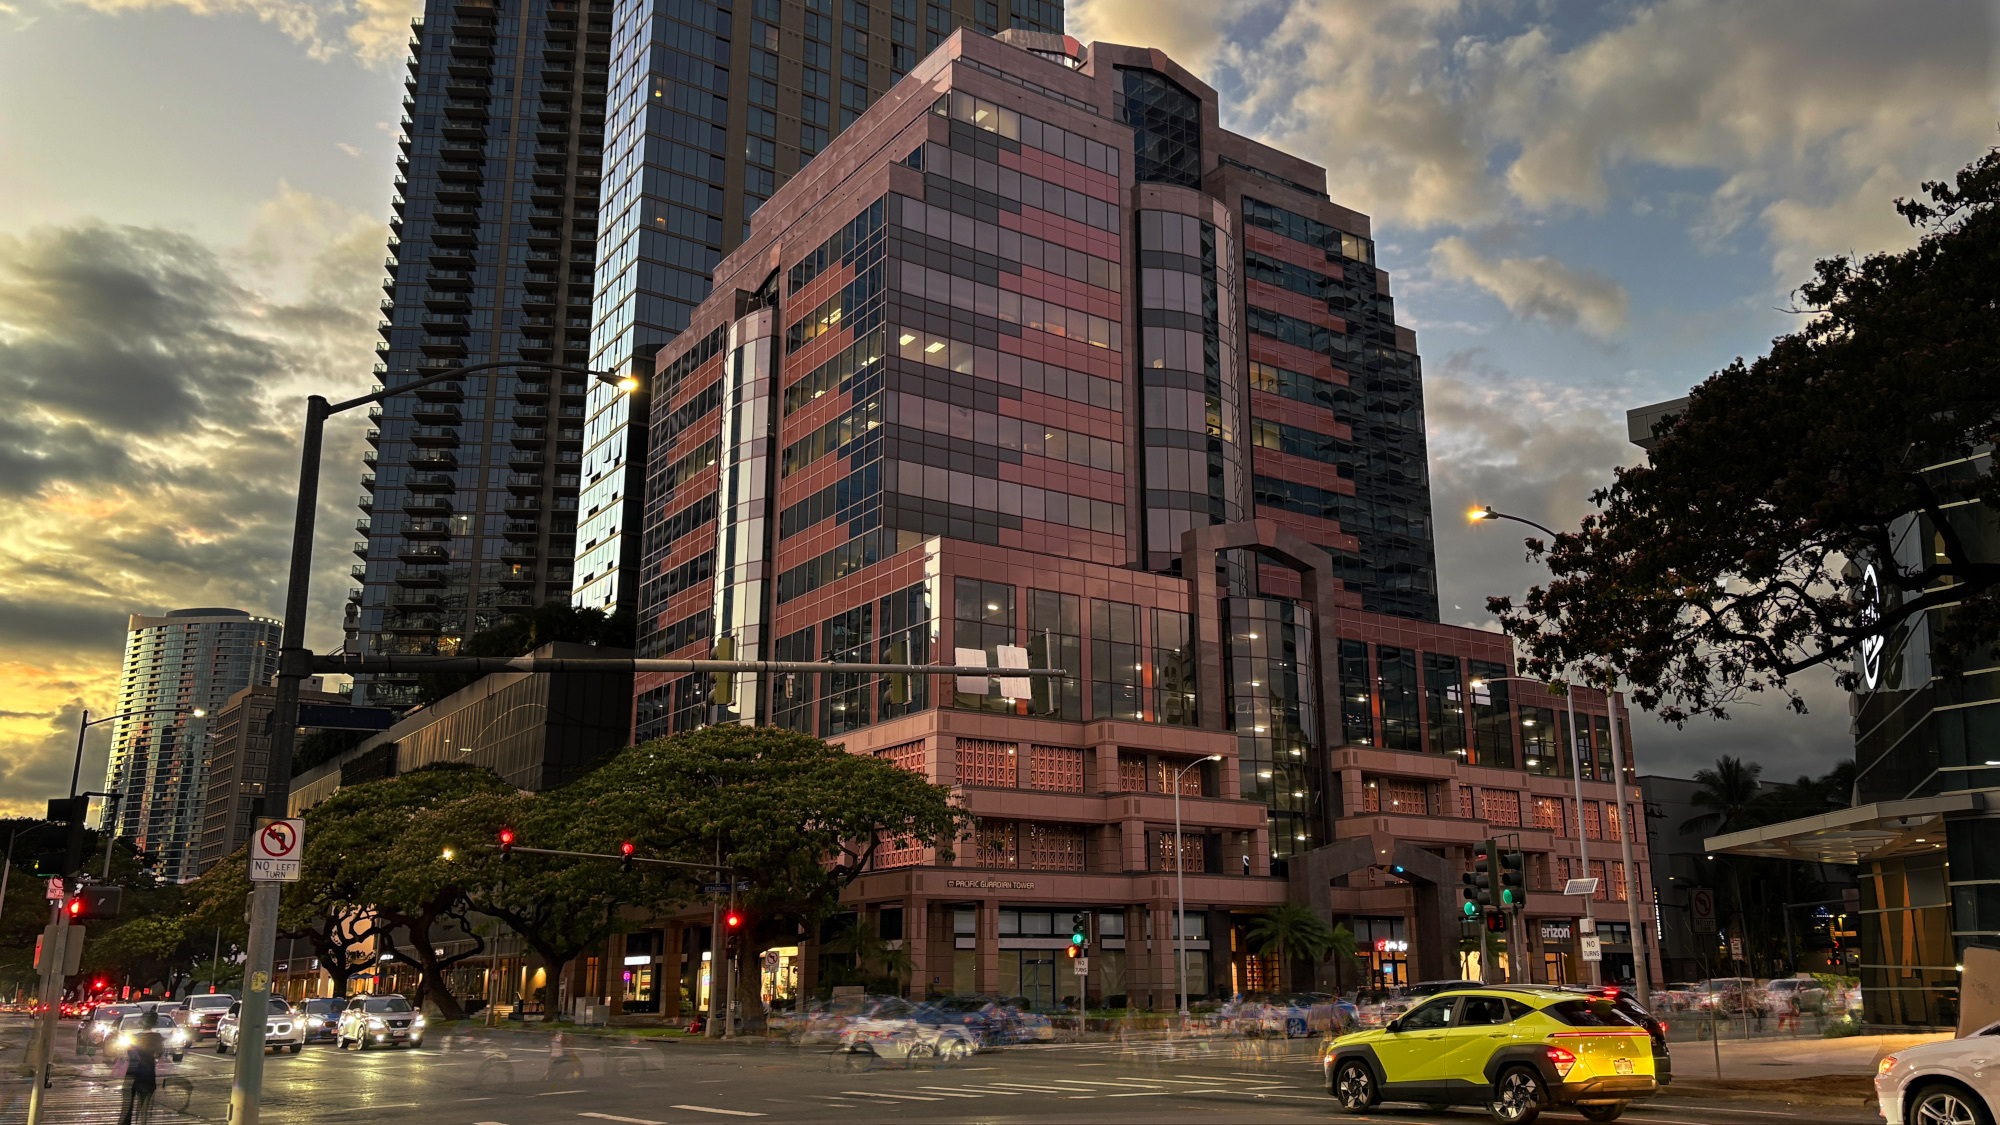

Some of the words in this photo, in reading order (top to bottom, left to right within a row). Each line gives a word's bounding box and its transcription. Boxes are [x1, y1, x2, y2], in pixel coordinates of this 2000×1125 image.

[255, 861, 270, 870] NO
[276, 863, 297, 871] LEFT
[955, 880, 979, 888] PACIFIC
[980, 880, 1012, 889] GUARDIAN
[1013, 881, 1035, 889] TOWER
[1541, 925, 1570, 938] erizon
[1586, 940, 1596, 948] NO
